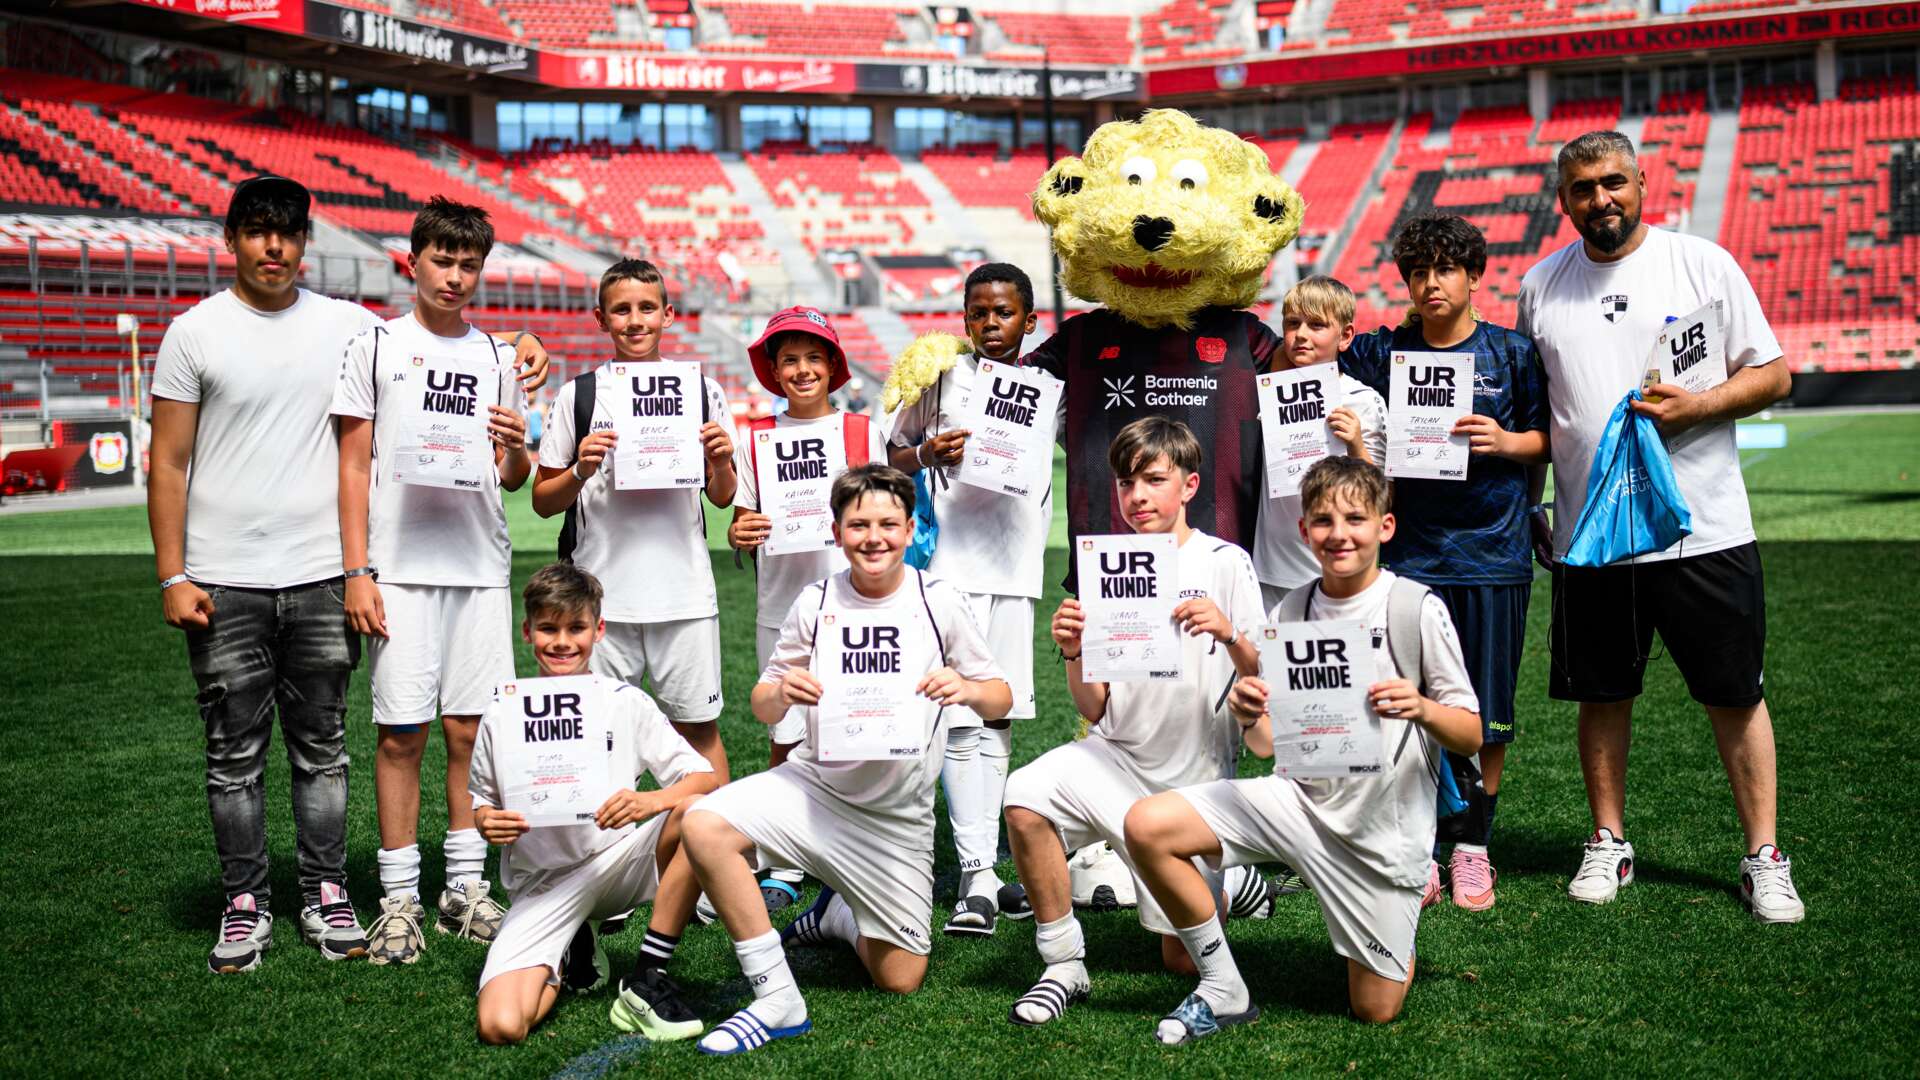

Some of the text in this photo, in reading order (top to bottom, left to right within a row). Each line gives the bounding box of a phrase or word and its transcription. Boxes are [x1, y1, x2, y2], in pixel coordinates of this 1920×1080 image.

[1671, 322, 1706, 356] UR
[1673, 340, 1708, 377] KUNDE
[393, 373, 406, 382] JA
[426, 369, 478, 397] UR
[631, 375, 682, 397] UR
[1144, 375, 1218, 390] Barmenia
[1408, 365, 1456, 388] UR
[422, 391, 477, 417] KUNDE
[992, 376, 1041, 409] UR
[1144, 392, 1208, 406] Gothaer
[1276, 379, 1324, 405] UR
[1407, 386, 1456, 408] KUNDE
[632, 397, 683, 417] KUNDE
[984, 396, 1037, 428] KUNDE
[1278, 400, 1326, 426] KUNDE
[430, 423, 450, 431] NICK
[775, 438, 827, 462] UR
[777, 458, 828, 482] KUNDE
[1100, 551, 1156, 575] UR
[1100, 576, 1157, 599] KUNDE
[842, 626, 901, 650] UR
[842, 651, 901, 674] KUNDE
[1284, 638, 1349, 665] UR
[1287, 664, 1352, 691] KUNDE
[523, 693, 582, 719] UR
[708, 690, 720, 704] JA
[1303, 703, 1328, 714] ERIC
[524, 717, 584, 743] KUNDE
[960, 859, 981, 869] AKO
[454, 881, 465, 890] JA
[1366, 941, 1392, 959] JAKO
